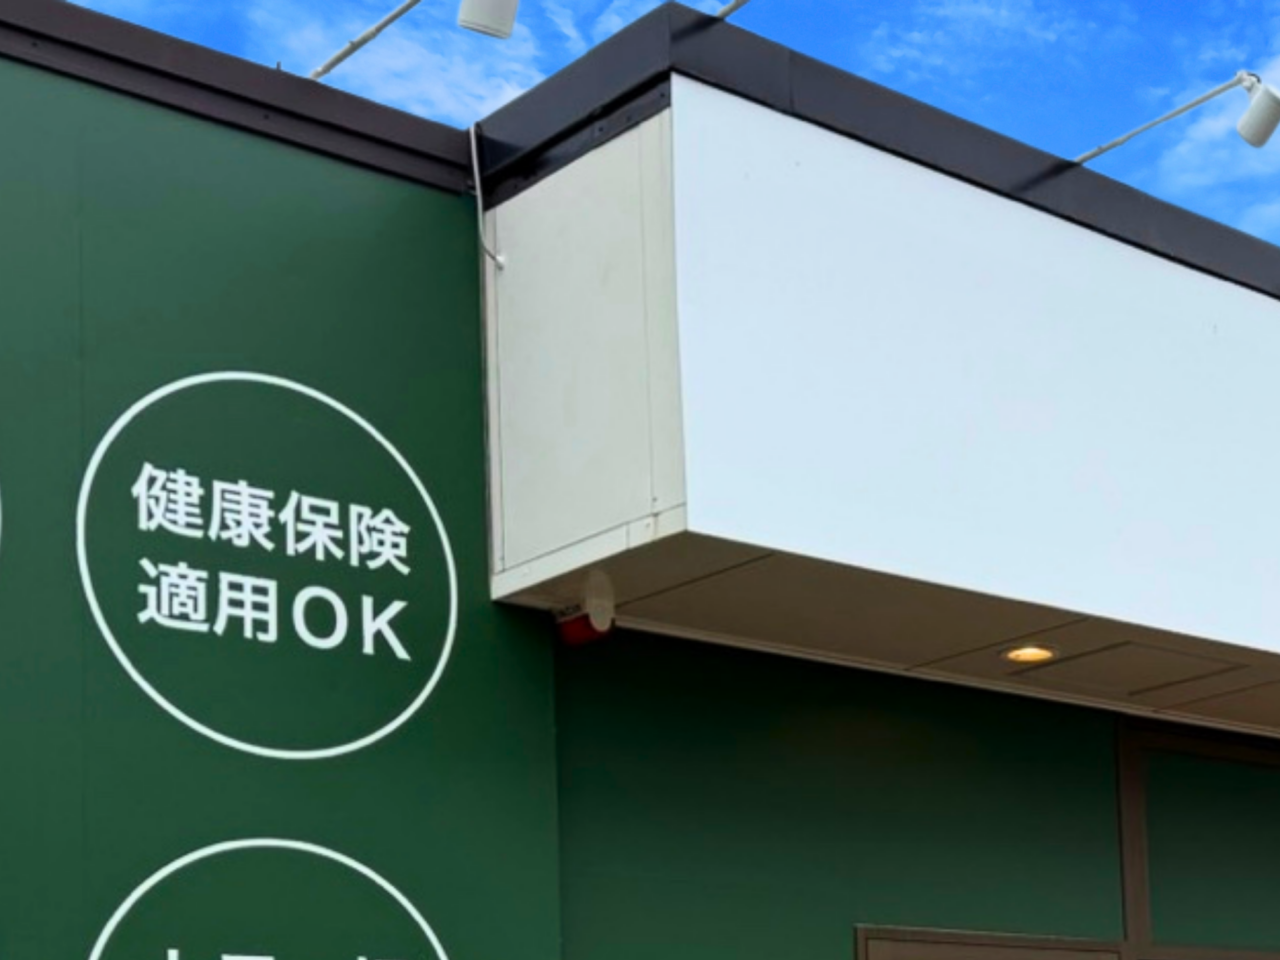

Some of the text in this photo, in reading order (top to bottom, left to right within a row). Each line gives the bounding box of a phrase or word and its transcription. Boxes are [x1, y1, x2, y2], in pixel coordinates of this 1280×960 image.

[130, 461, 411, 575] 健康保険
[137, 557, 411, 661] 適用OK
